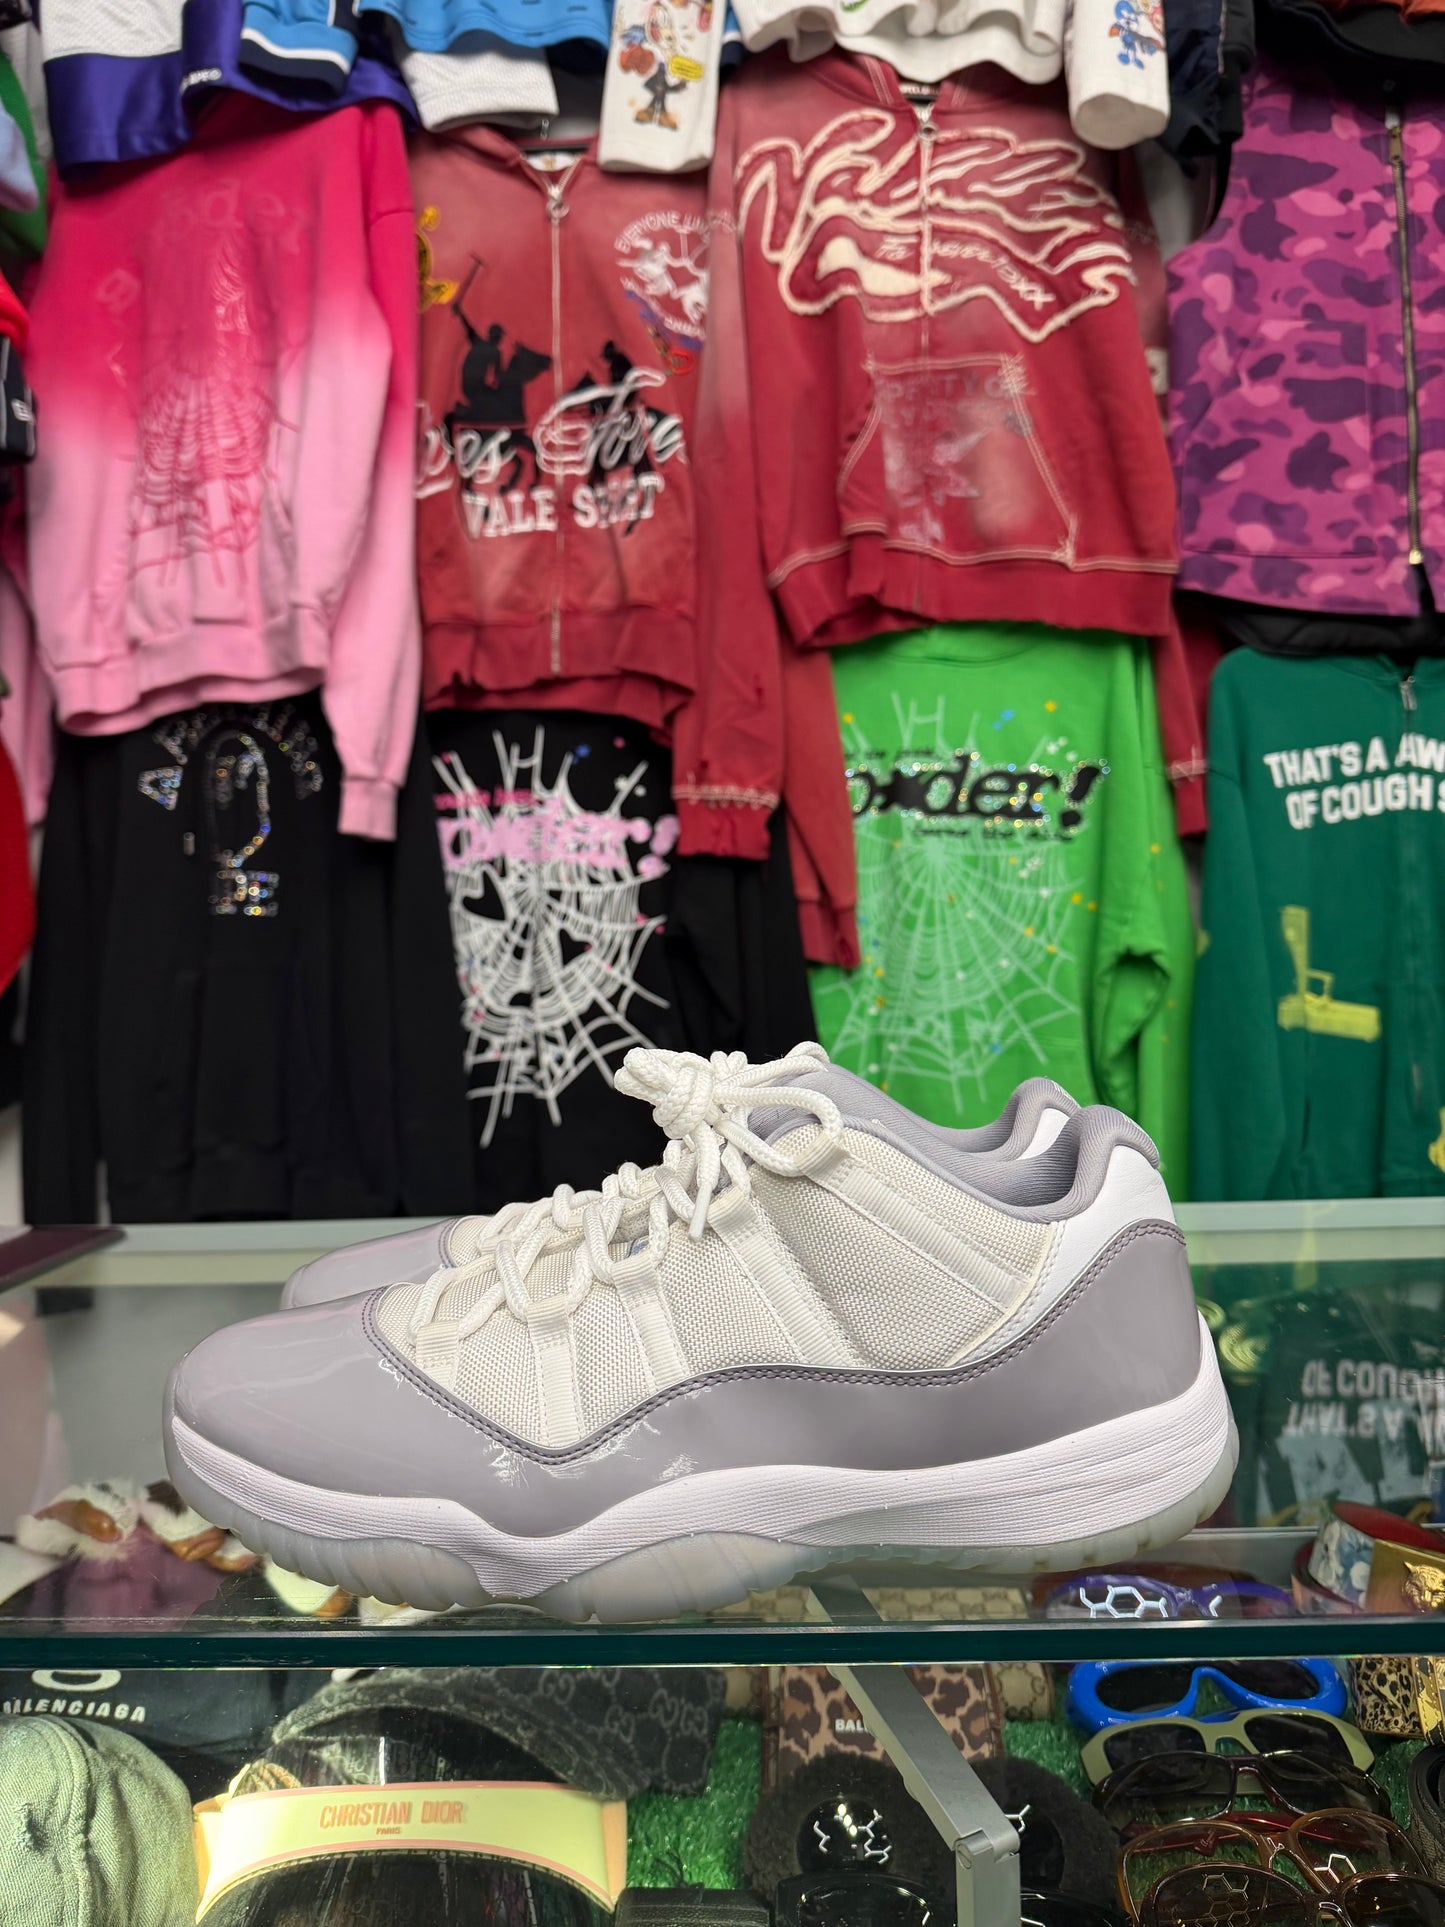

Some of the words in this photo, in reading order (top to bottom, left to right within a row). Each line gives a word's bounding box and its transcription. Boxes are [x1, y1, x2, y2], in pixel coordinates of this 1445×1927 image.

[462, 486, 558, 539] VALE
[1263, 741, 1363, 788] THAT'S
[1365, 735, 1389, 773] A
[1285, 789, 1319, 830] OF
[1321, 772, 1434, 824] COUGH
[319, 1801, 413, 1829] CHRISTIAN
[420, 1800, 465, 1825] DIOR
[376, 1827, 402, 1835] PARIS
